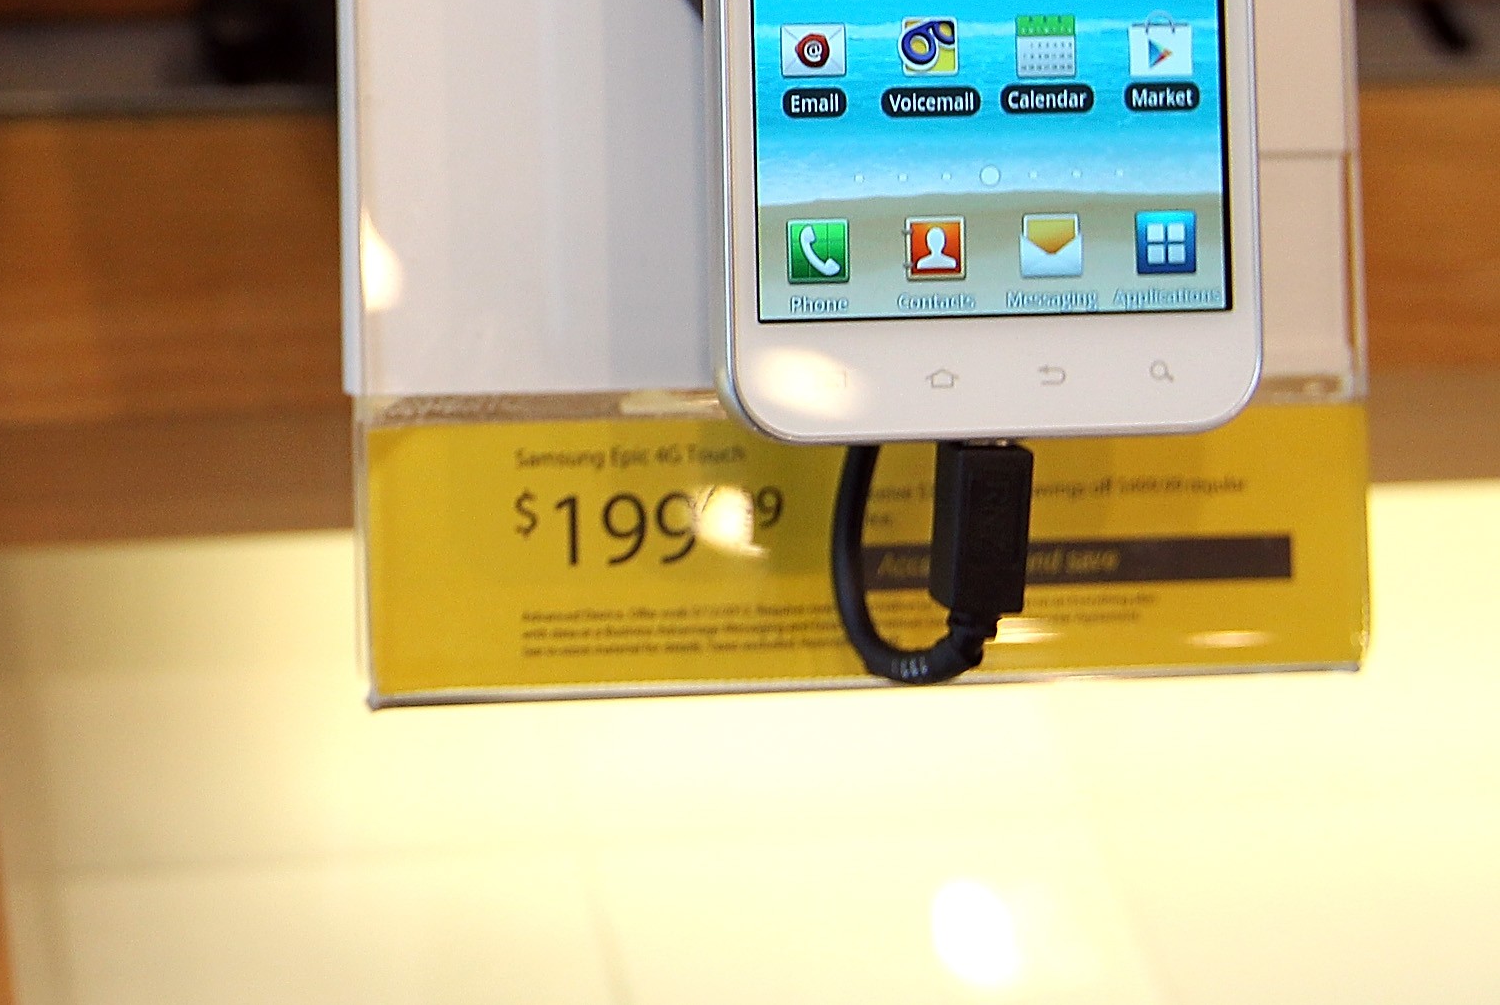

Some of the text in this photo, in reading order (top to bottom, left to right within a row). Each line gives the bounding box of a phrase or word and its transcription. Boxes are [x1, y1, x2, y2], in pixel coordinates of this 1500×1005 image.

[789, 93, 840, 113] Email
[888, 91, 975, 113] Voicemail
[1007, 89, 1088, 110] Calendar
[1131, 87, 1194, 108] Market
[789, 294, 850, 316] Phone
[896, 292, 976, 311] Contacts
[1005, 289, 1100, 312] Messaging
[1112, 286, 1220, 308] Applications
[514, 448, 605, 472] Samsung
[610, 446, 649, 468] Epic
